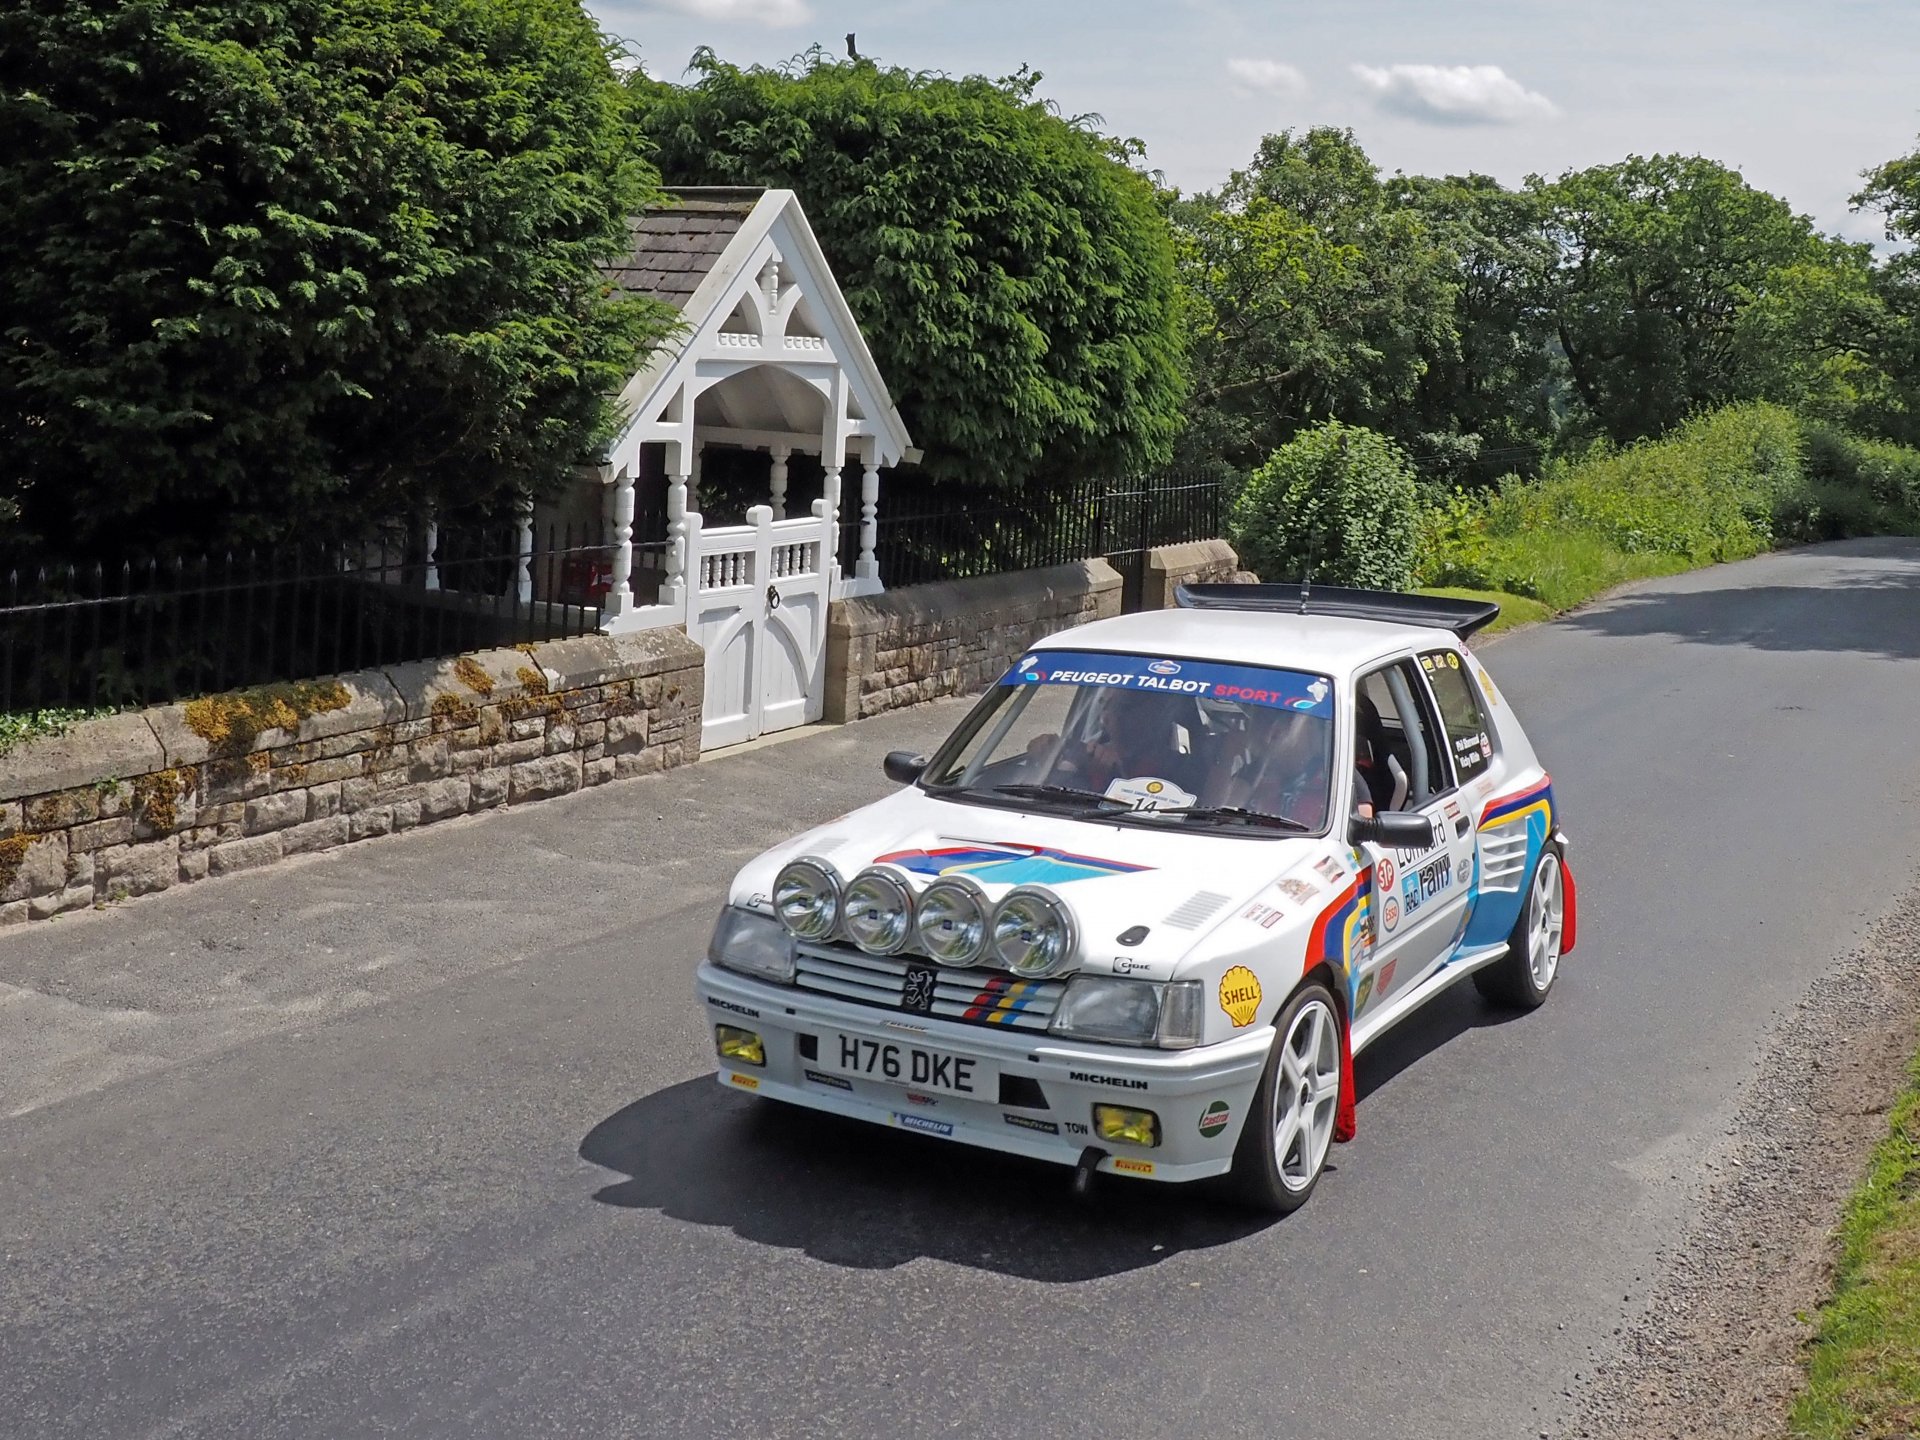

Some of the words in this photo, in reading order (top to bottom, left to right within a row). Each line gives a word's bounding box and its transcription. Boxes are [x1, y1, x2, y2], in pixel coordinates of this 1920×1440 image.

[1050, 671, 1133, 685] PEUGEOT
[1138, 676, 1210, 693] TALBOT
[1214, 685, 1281, 703] SPORT
[1132, 798, 1158, 813] 14
[1379, 860, 1393, 888] STP
[1419, 856, 1451, 901] rally
[1405, 889, 1418, 912] RAC
[1224, 985, 1257, 1005] SHELL
[708, 996, 759, 1018] MICHELIN
[838, 1033, 901, 1078] H76
[911, 1050, 976, 1093] DKE
[1070, 1071, 1148, 1090] MICHELIN
[904, 1116, 950, 1133] MICHELIN
[1064, 1122, 1088, 1135] TOW
